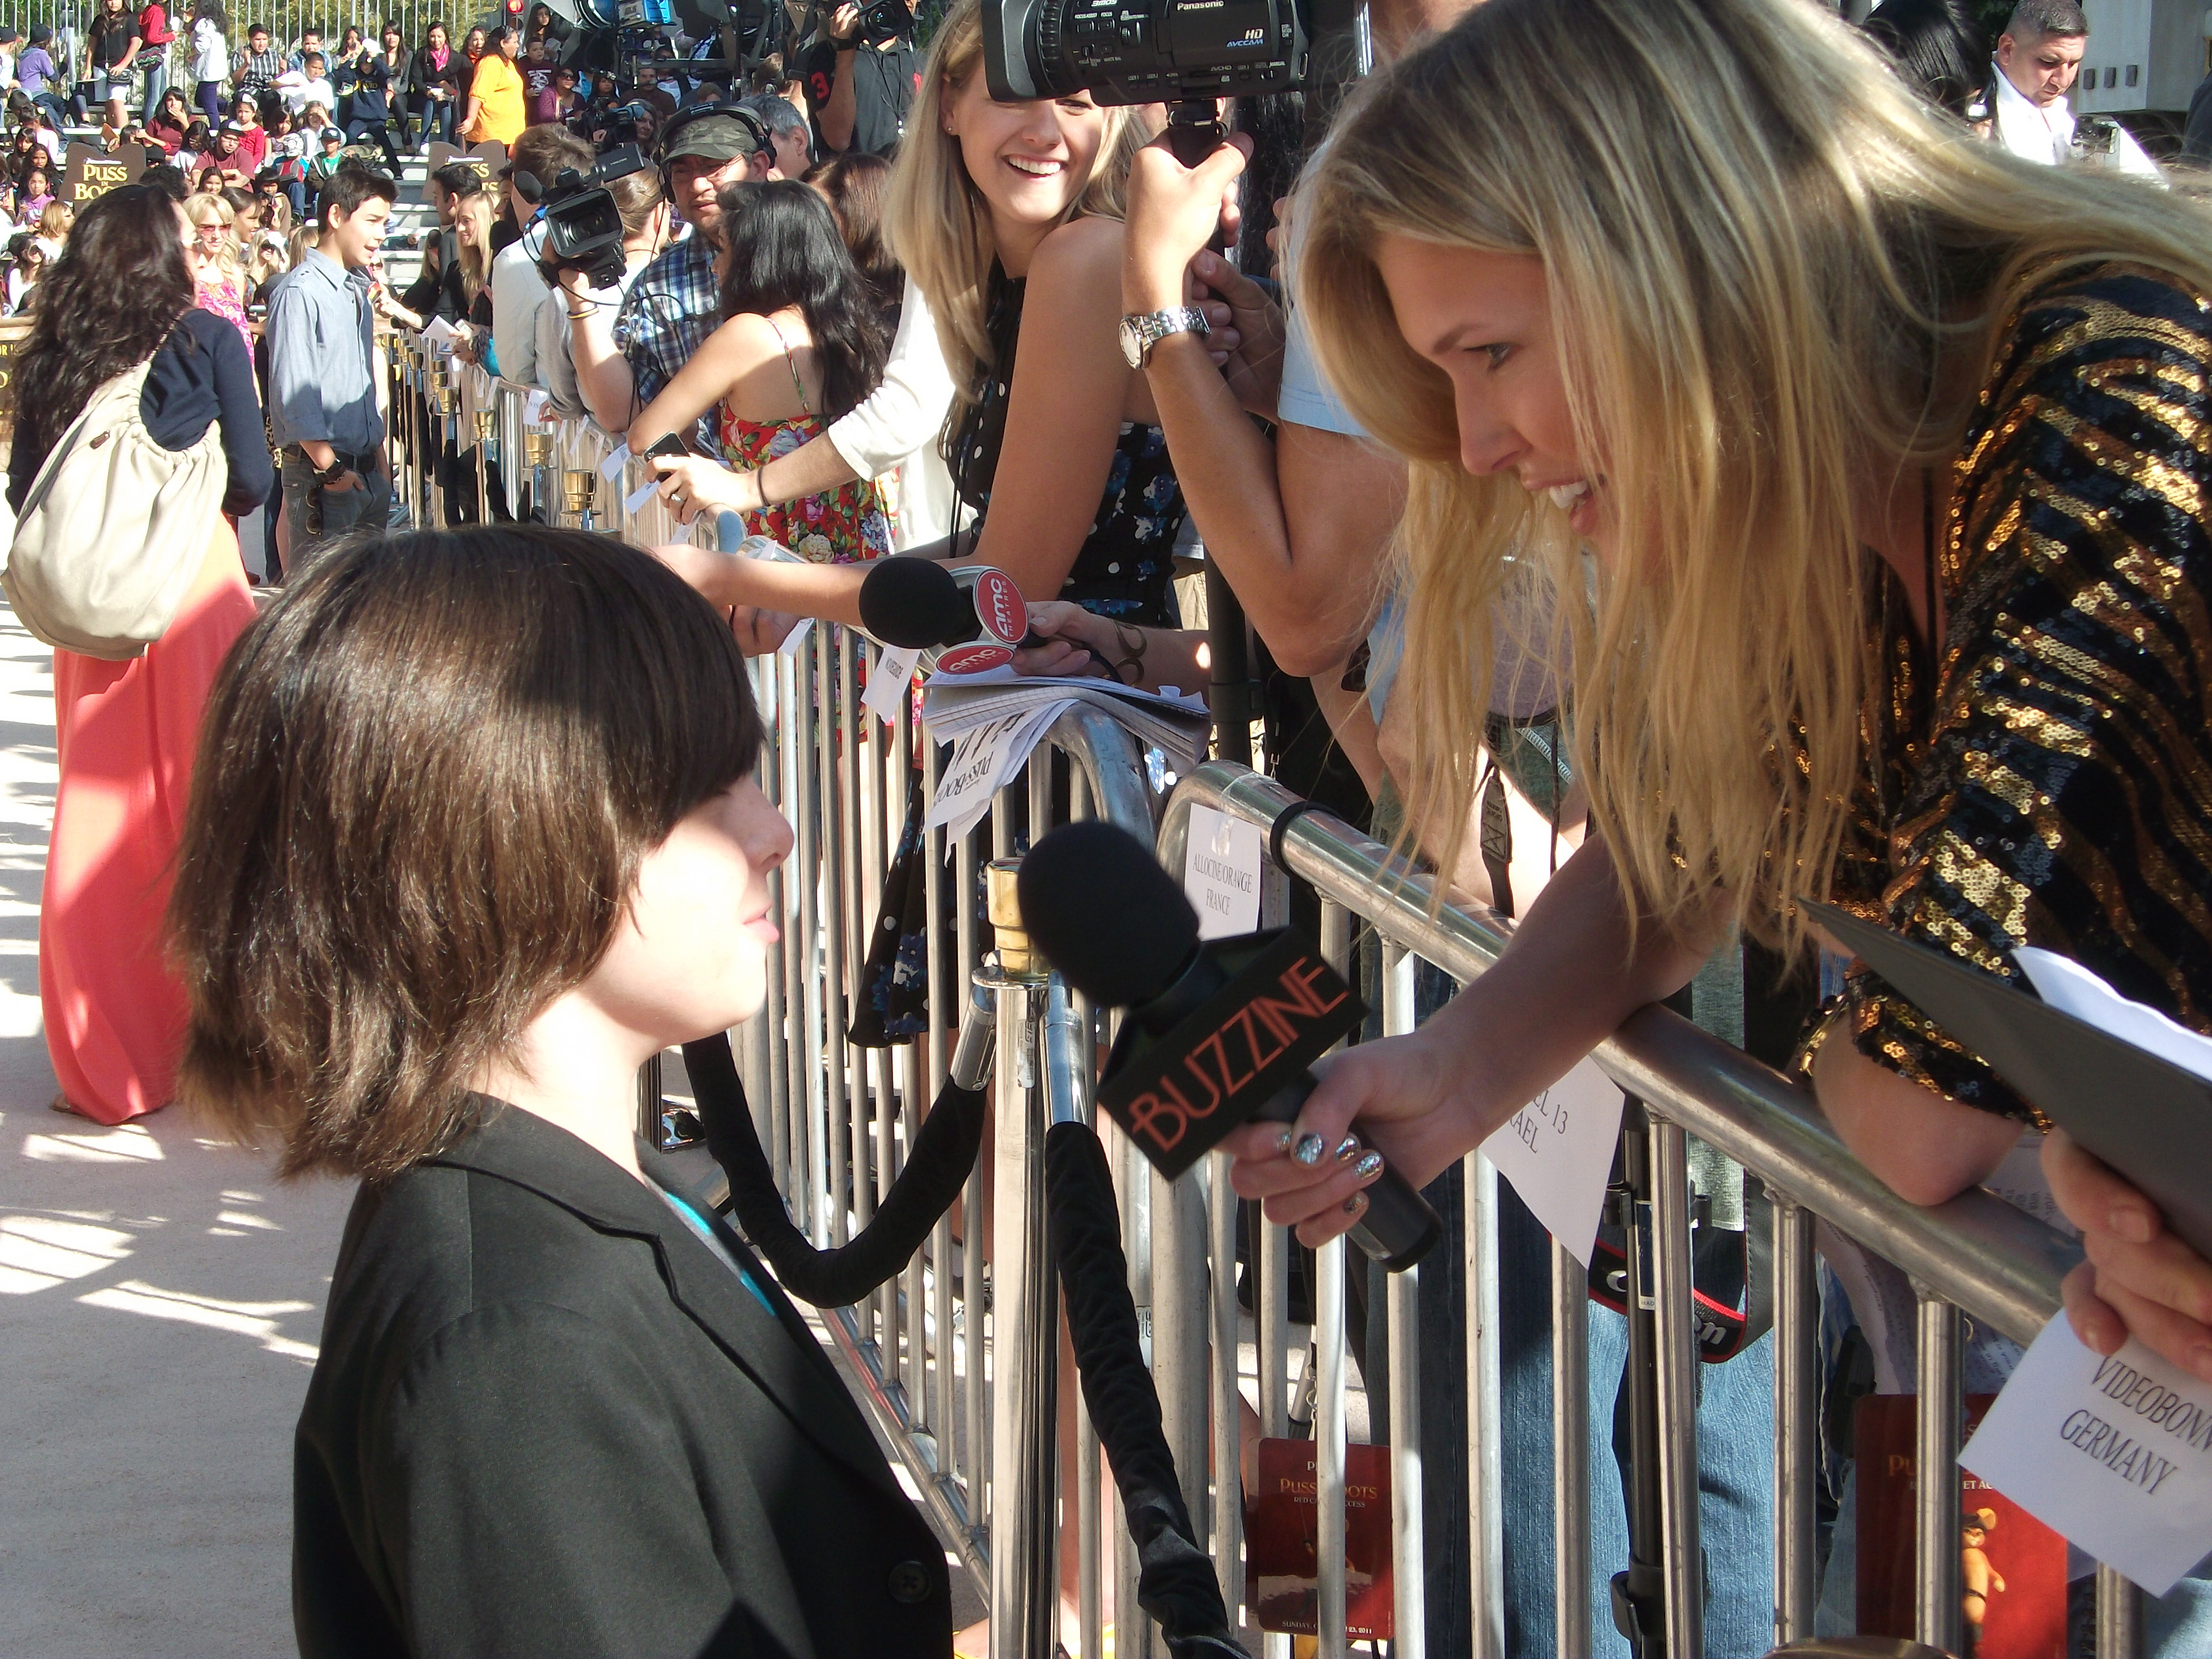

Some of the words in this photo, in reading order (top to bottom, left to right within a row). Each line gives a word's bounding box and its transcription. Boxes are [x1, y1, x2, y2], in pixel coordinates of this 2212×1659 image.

[1177, 0, 1224, 11] Panasonic
[1227, 39, 1264, 47] AVCCAM
[1245, 29, 1264, 39] HD
[811, 72, 829, 100] 3
[83, 164, 128, 181] PUSS
[990, 577, 1009, 637] amc
[1002, 581, 1014, 638] THEATRES
[1206, 888, 1232, 916] FRANCE
[1129, 956, 1350, 1153] BUZZINE
[1552, 1104, 1568, 1134] 13
[2060, 1409, 2178, 1495] GERMANY
[1280, 1478, 1317, 1494] PUSS
[1345, 1485, 1378, 1500] OTS
